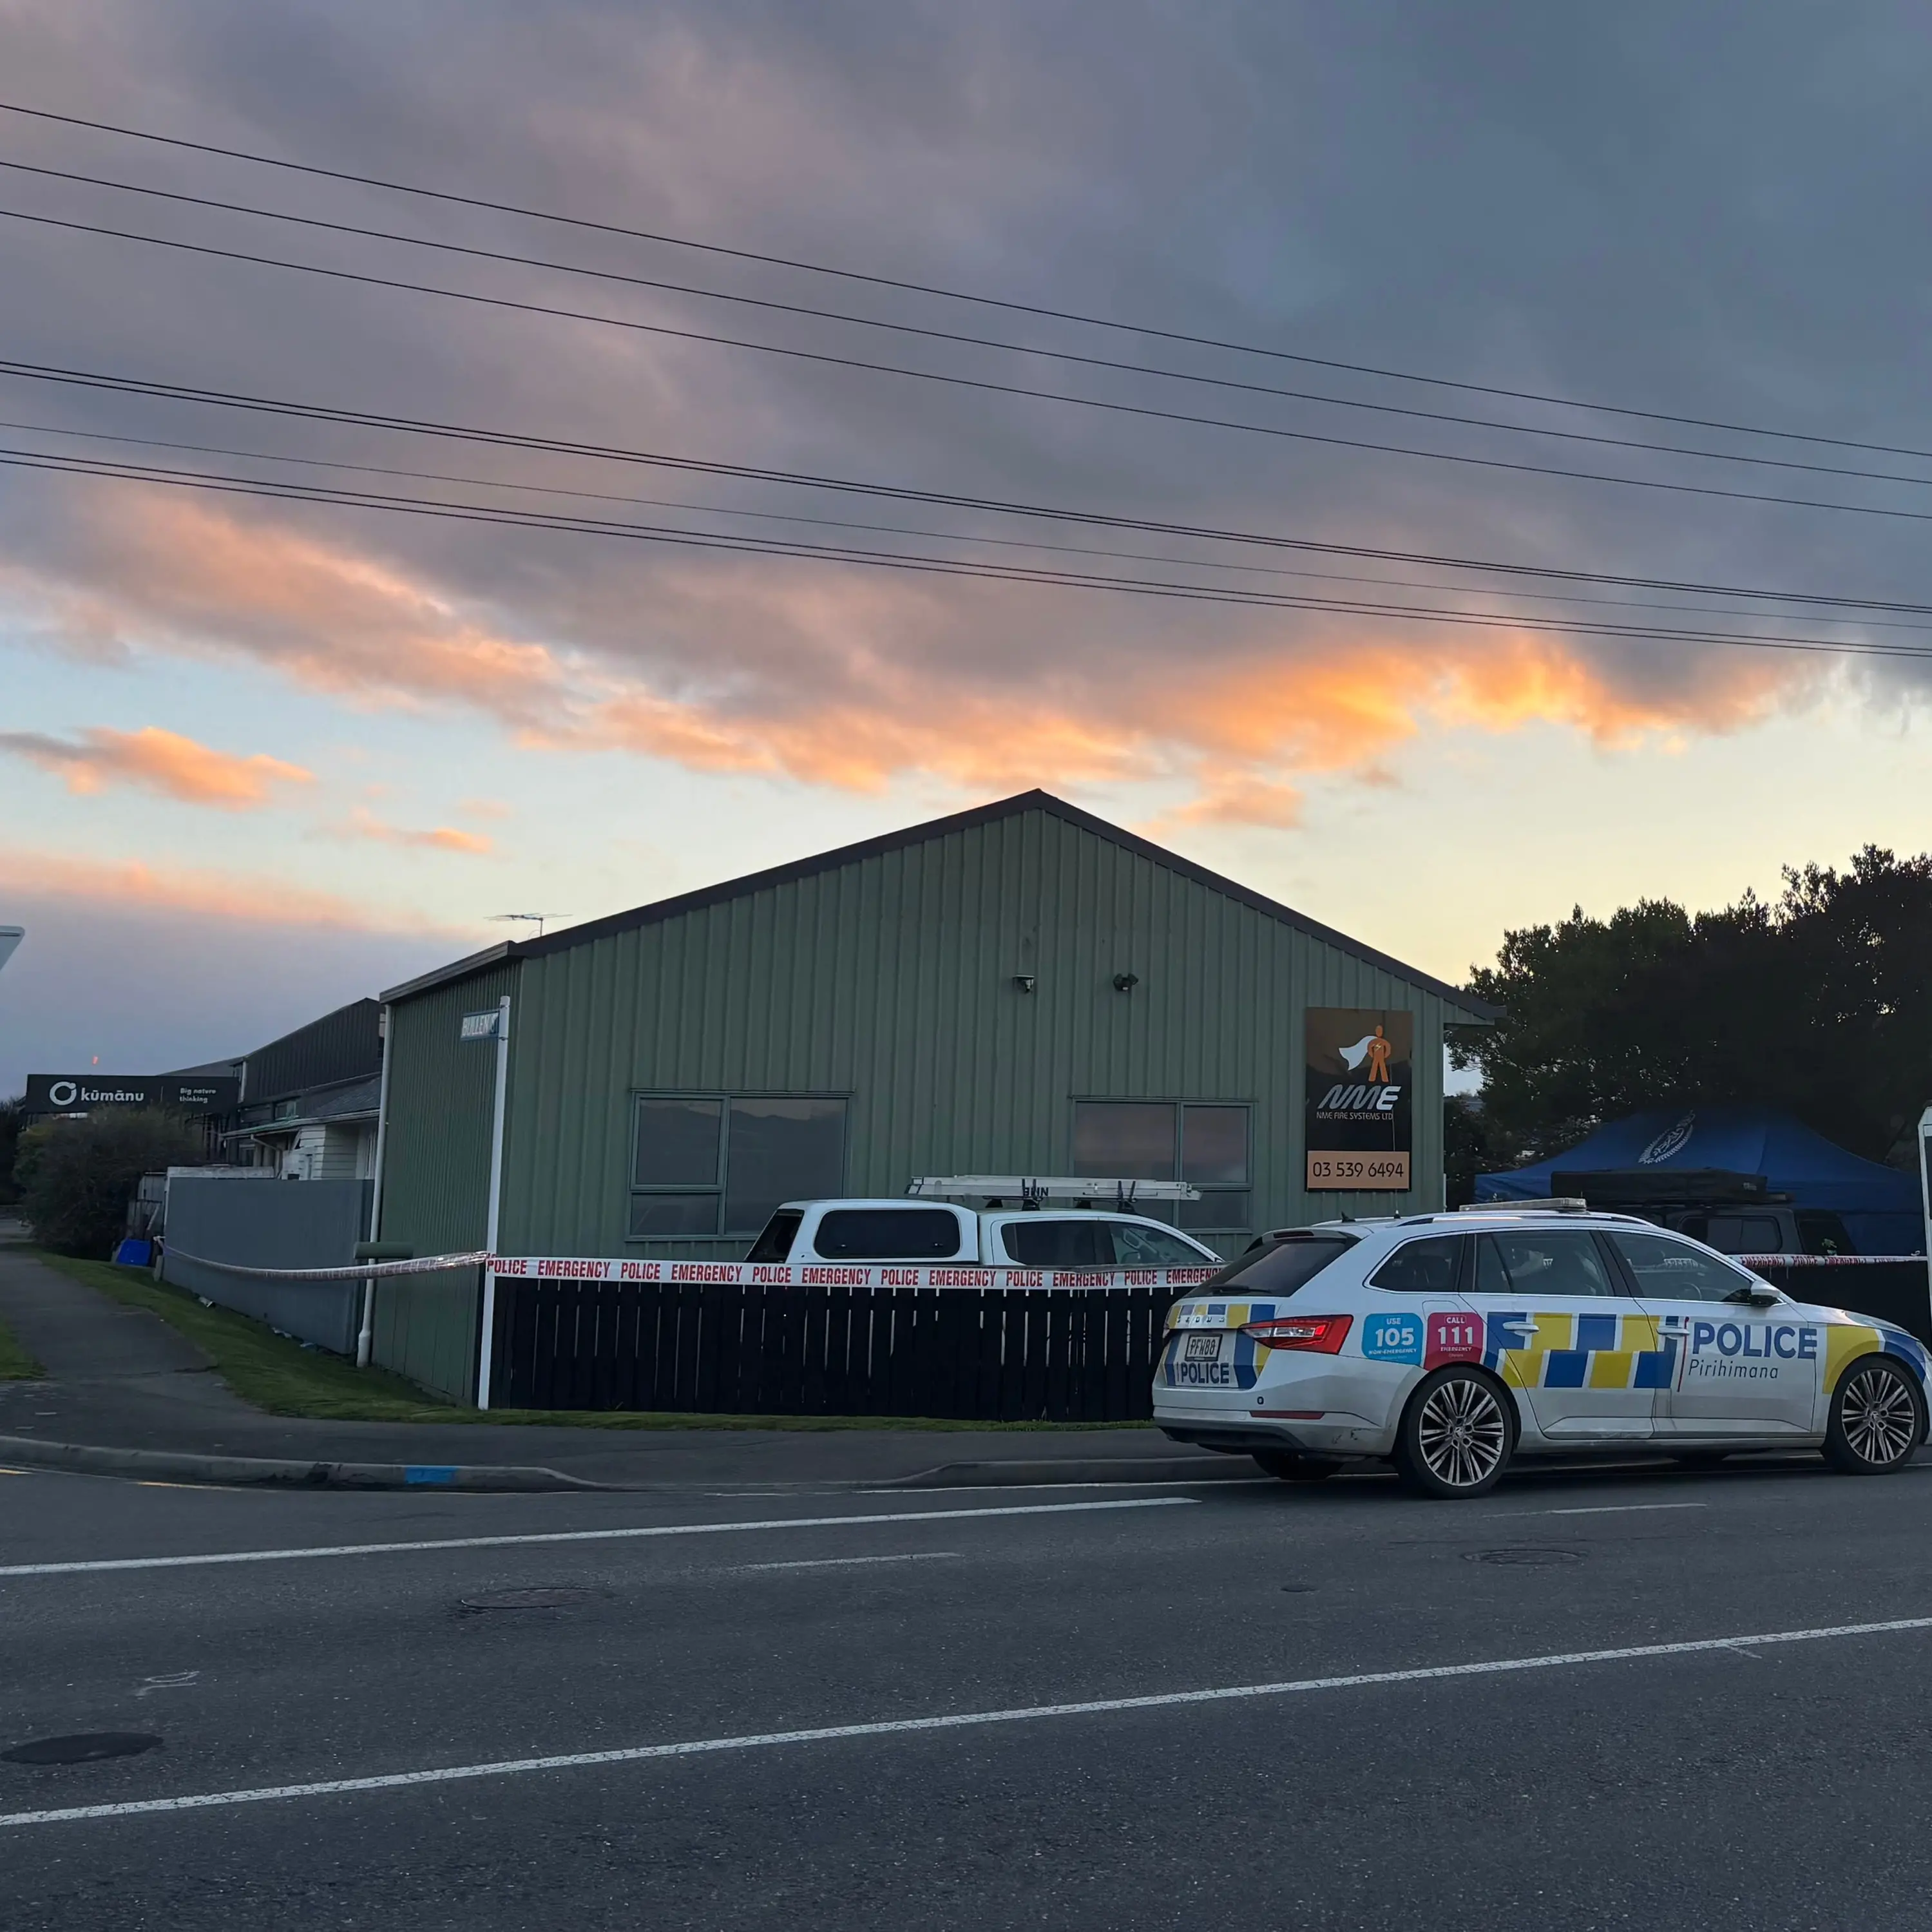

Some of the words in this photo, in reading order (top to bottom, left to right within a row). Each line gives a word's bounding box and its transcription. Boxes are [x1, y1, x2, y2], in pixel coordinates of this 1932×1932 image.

[81, 1087, 144, 1102] kūmānu
[180, 1087, 192, 1096] Big
[180, 1095, 208, 1104] thinking
[1318, 1084, 1401, 1111] NME
[1349, 1112, 1380, 1120] SYSTEMS
[1312, 1162, 1331, 1178] 03
[1336, 1162, 1363, 1178] 539
[1368, 1162, 1404, 1178] 6494
[486, 1259, 528, 1276] POLICE
[537, 1259, 611, 1279] EMERGENCY
[620, 1262, 661, 1280] POLICE
[671, 1264, 743, 1282] EMERGENCY
[752, 1266, 792, 1283] POLICE
[801, 1267, 872, 1285] EMERGENCY
[881, 1269, 919, 1286] POLICE
[929, 1270, 997, 1287] EMERGENCY
[1006, 1271, 1043, 1287] POLICE
[1052, 1272, 1116, 1287] EMERGENCY
[1124, 1269, 1158, 1286] POLICE
[1166, 1267, 1223, 1285] EMERGENC
[1375, 1328, 1415, 1347] 105
[1438, 1326, 1474, 1344] 111
[1692, 1322, 1817, 1359] POLICE
[1181, 1363, 1230, 1384] POLICE
[1688, 1359, 1779, 1379] Pirihimana
